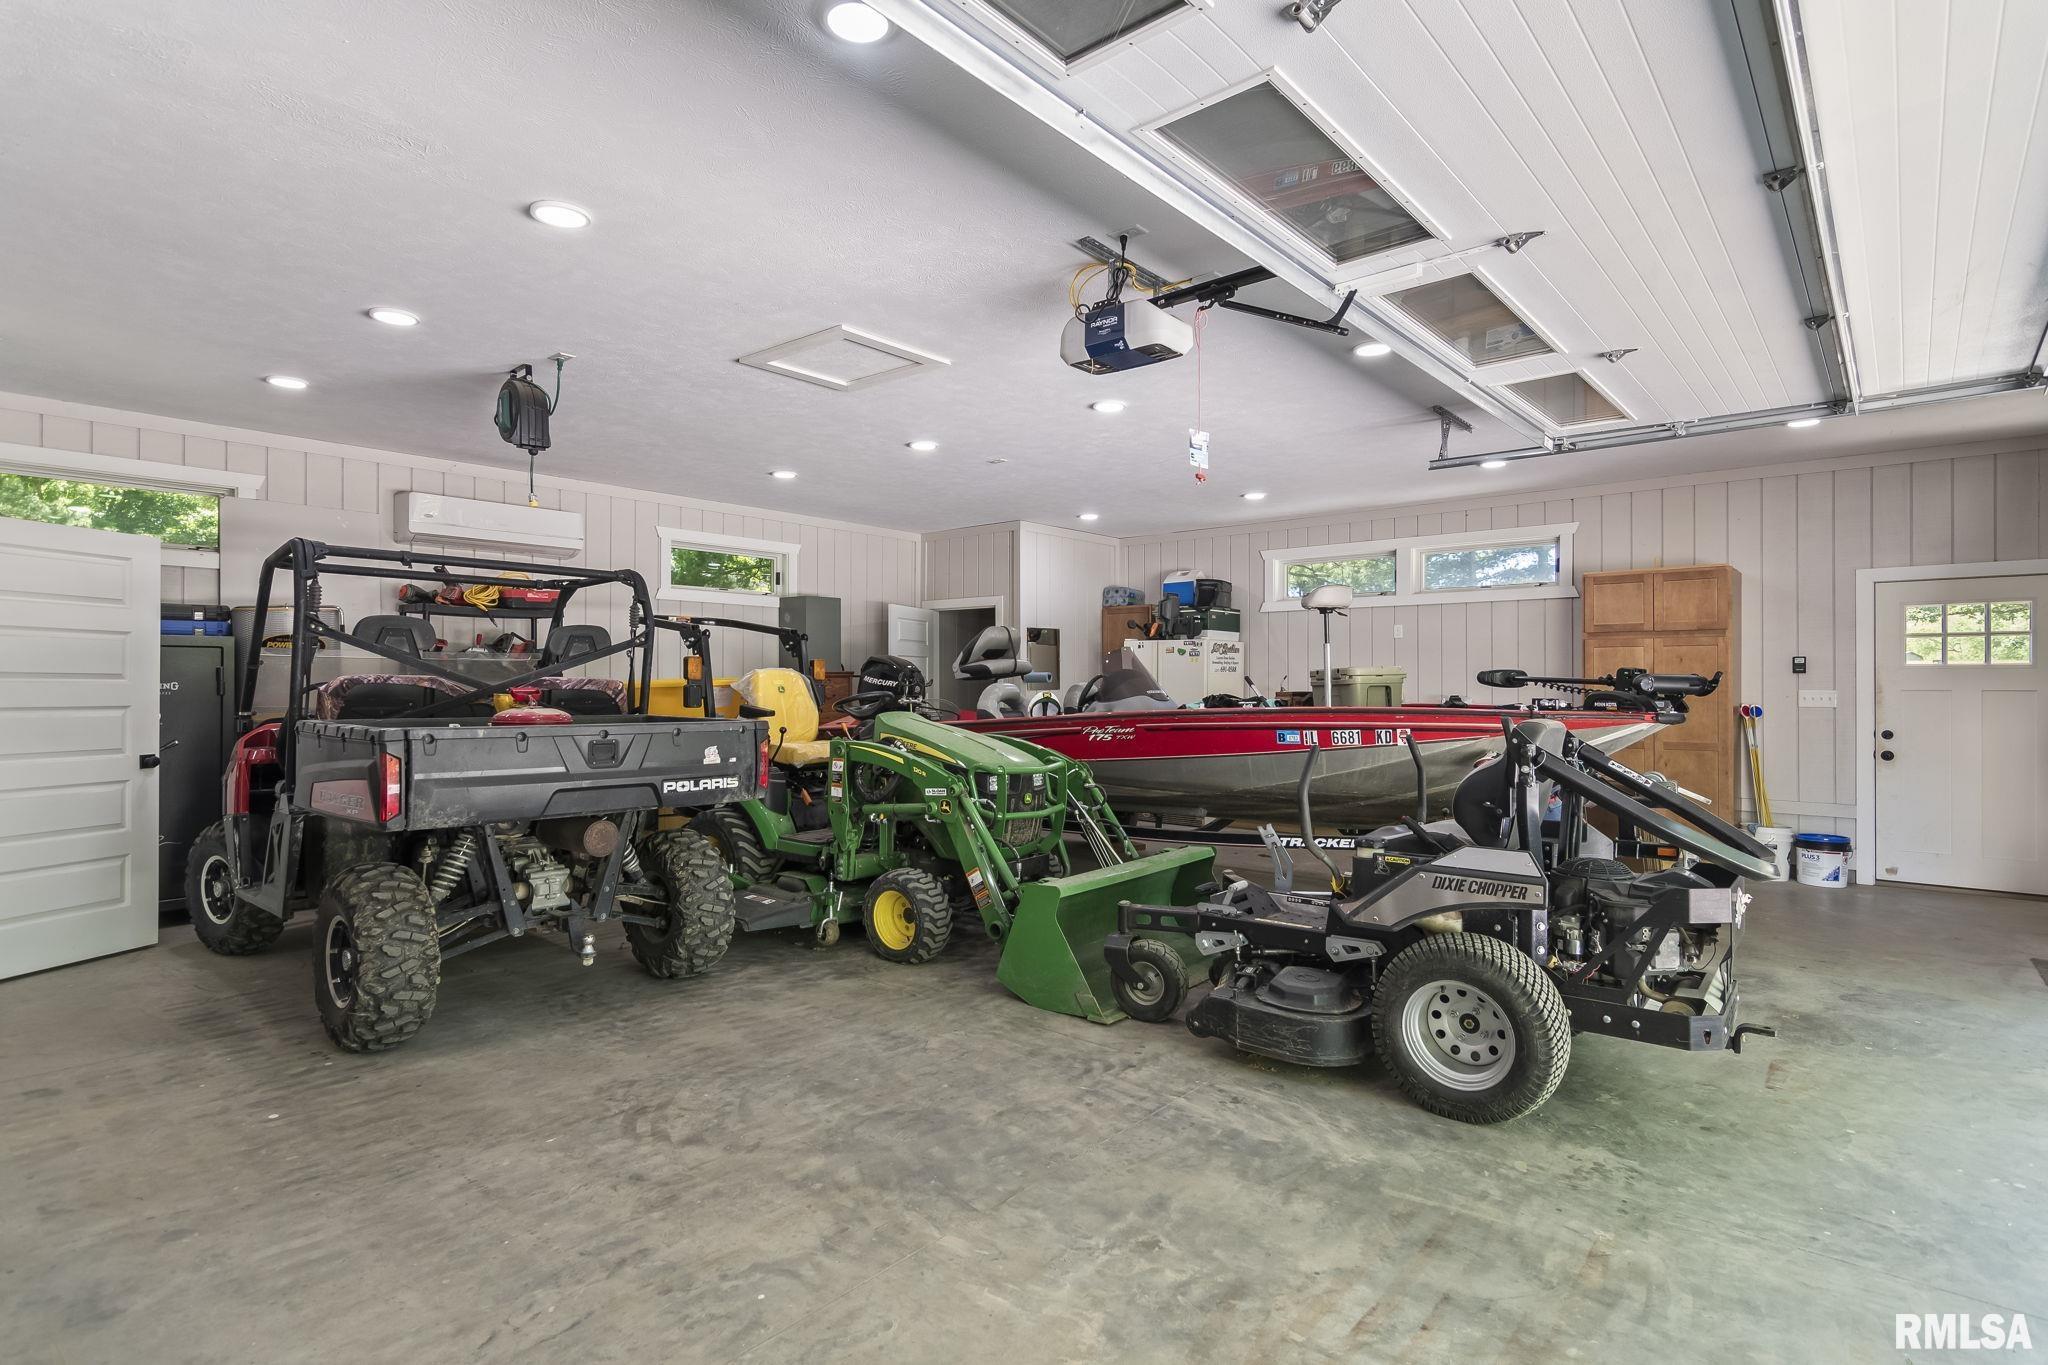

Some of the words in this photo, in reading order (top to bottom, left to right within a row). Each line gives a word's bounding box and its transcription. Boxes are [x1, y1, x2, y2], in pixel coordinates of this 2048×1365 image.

[1090, 316, 1118, 328] RAYNOR
[863, 675, 899, 687] MERCURY
[1332, 730, 1361, 745] 6681
[1376, 730, 1392, 744] KD
[663, 777, 739, 793] POLARIS
[1280, 837, 1355, 848] TRCKE
[1801, 852, 1816, 860] PLUS
[1431, 875, 1467, 893] DIXIE
[1468, 880, 1528, 900] CHOPPER
